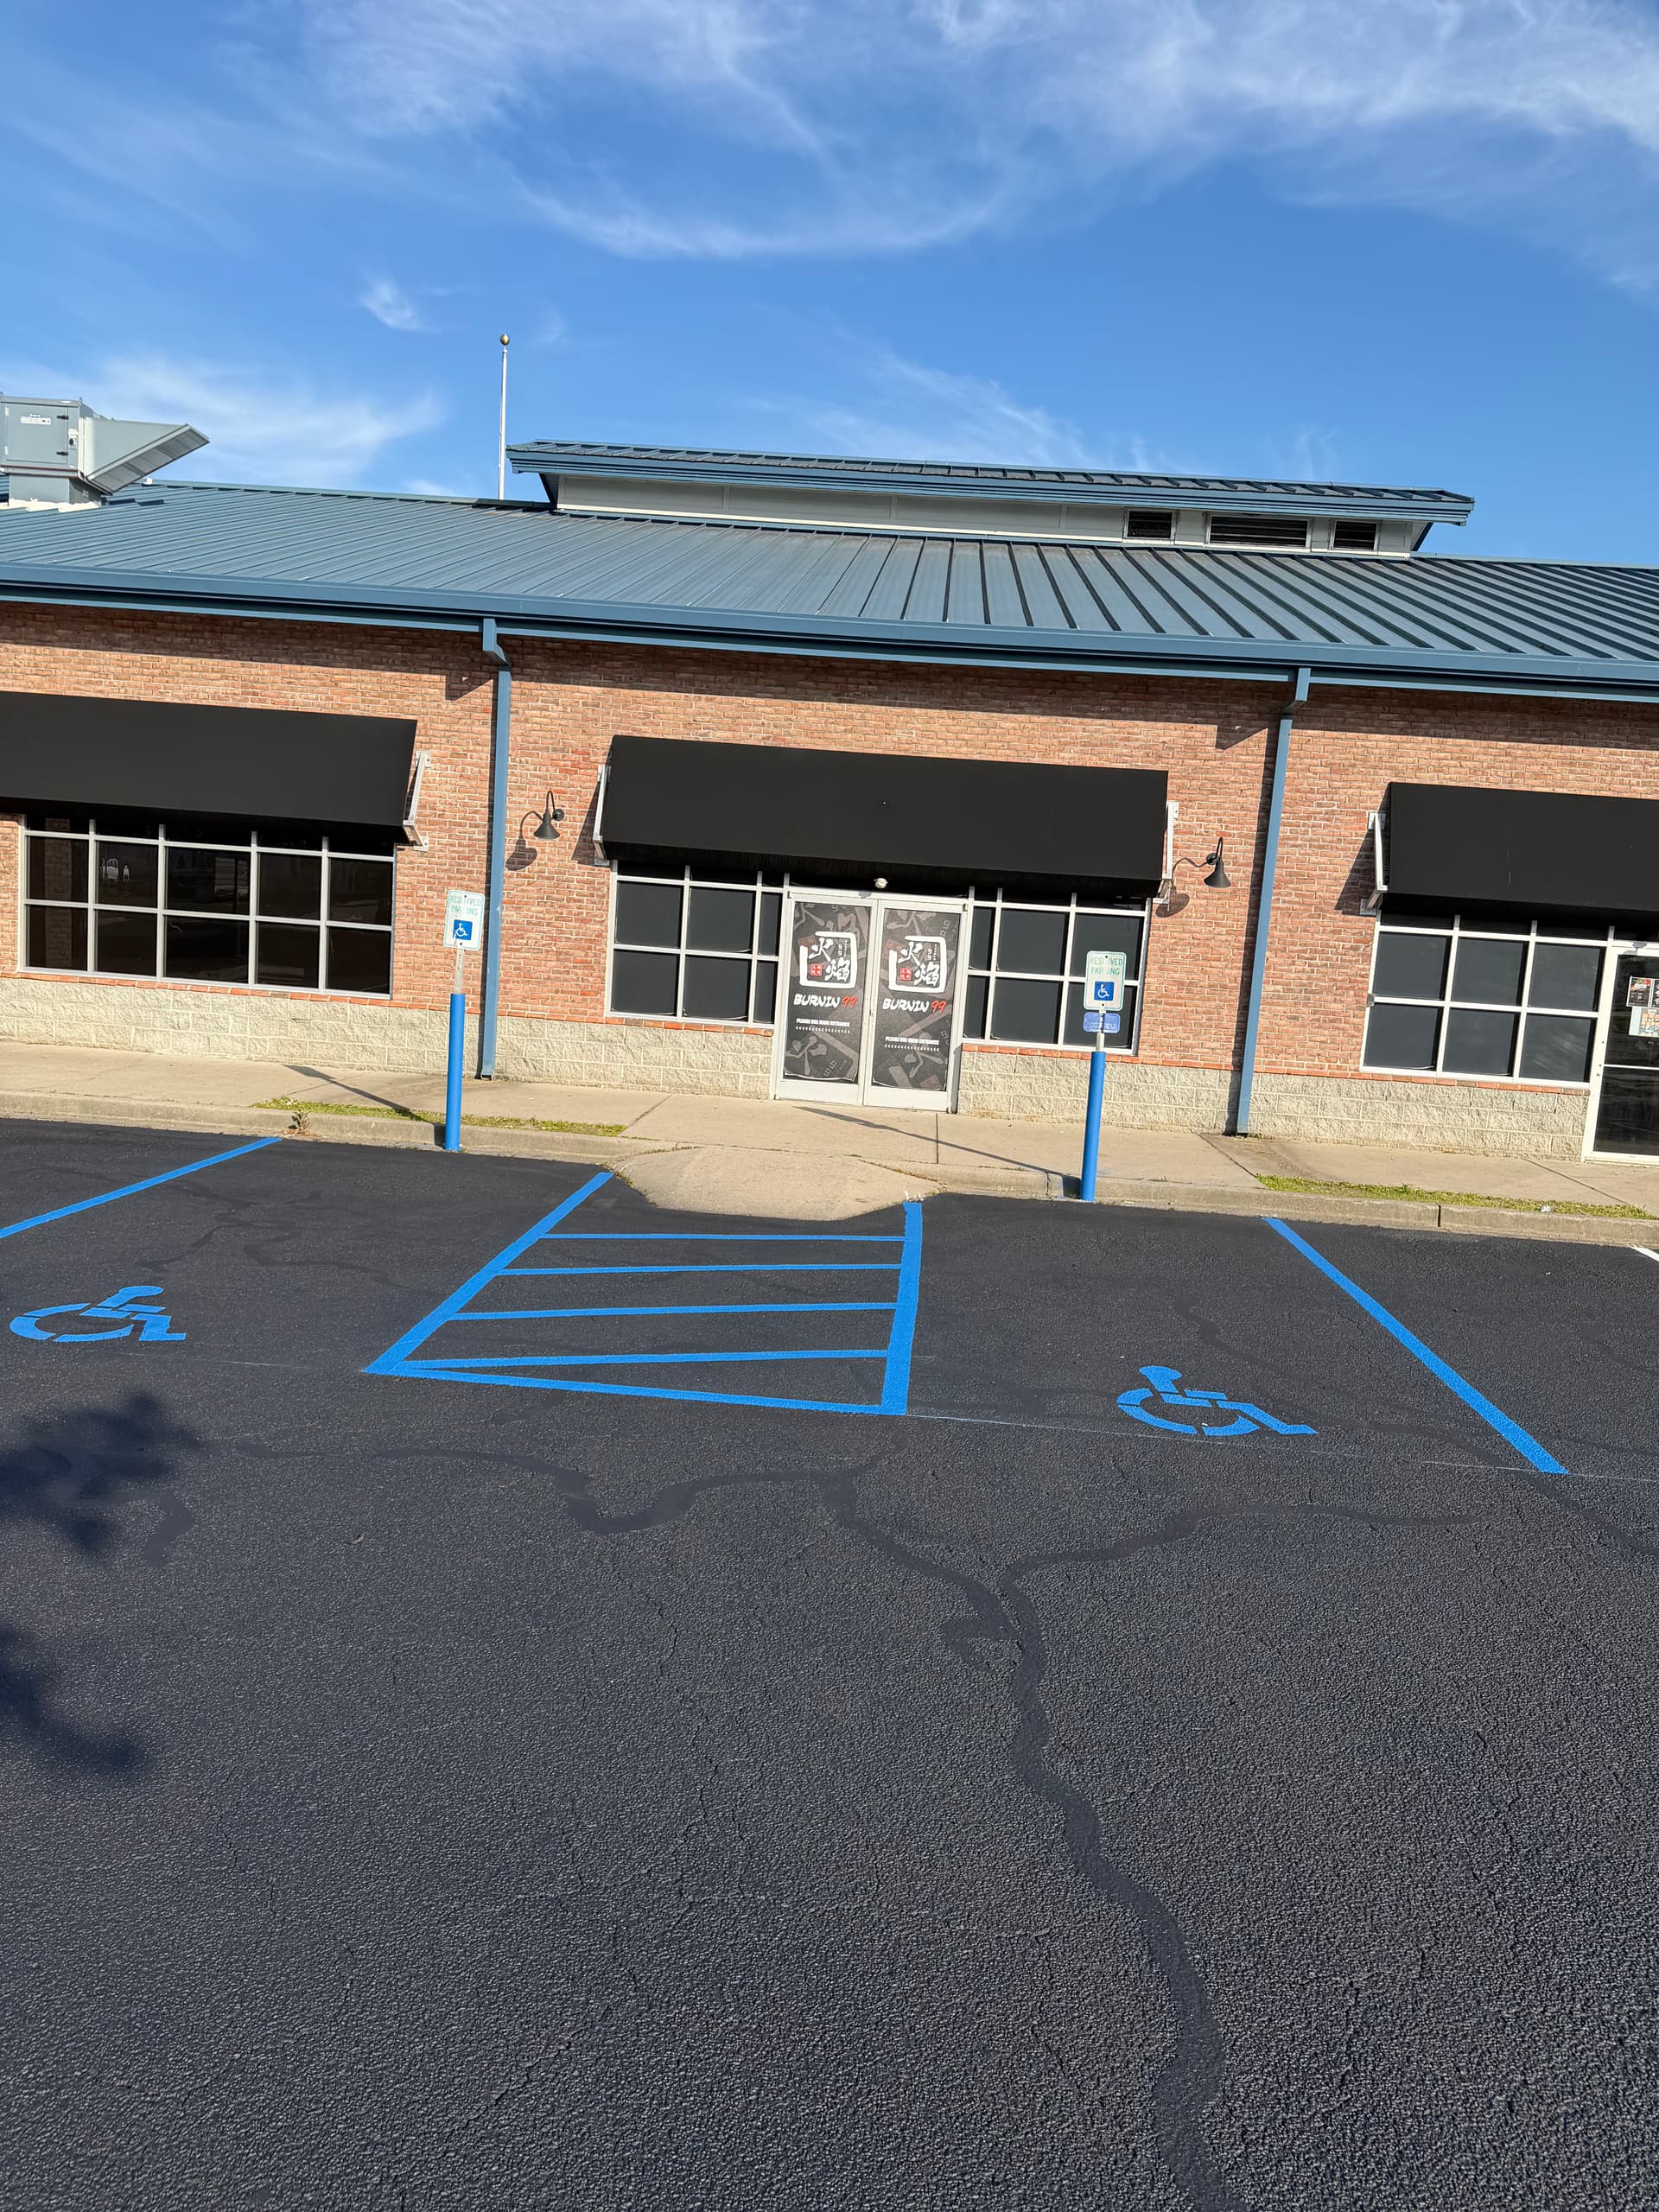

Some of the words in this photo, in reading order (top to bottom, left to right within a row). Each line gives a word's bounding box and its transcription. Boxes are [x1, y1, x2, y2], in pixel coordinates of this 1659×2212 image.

[451, 906, 479, 916] PARING
[1090, 957, 1122, 966] RESVED
[1091, 967, 1120, 976] PARING
[793, 994, 841, 1008] BURNIN
[842, 995, 858, 1010] 99
[882, 998, 930, 1013] BURNIN
[931, 1000, 947, 1014] 99
